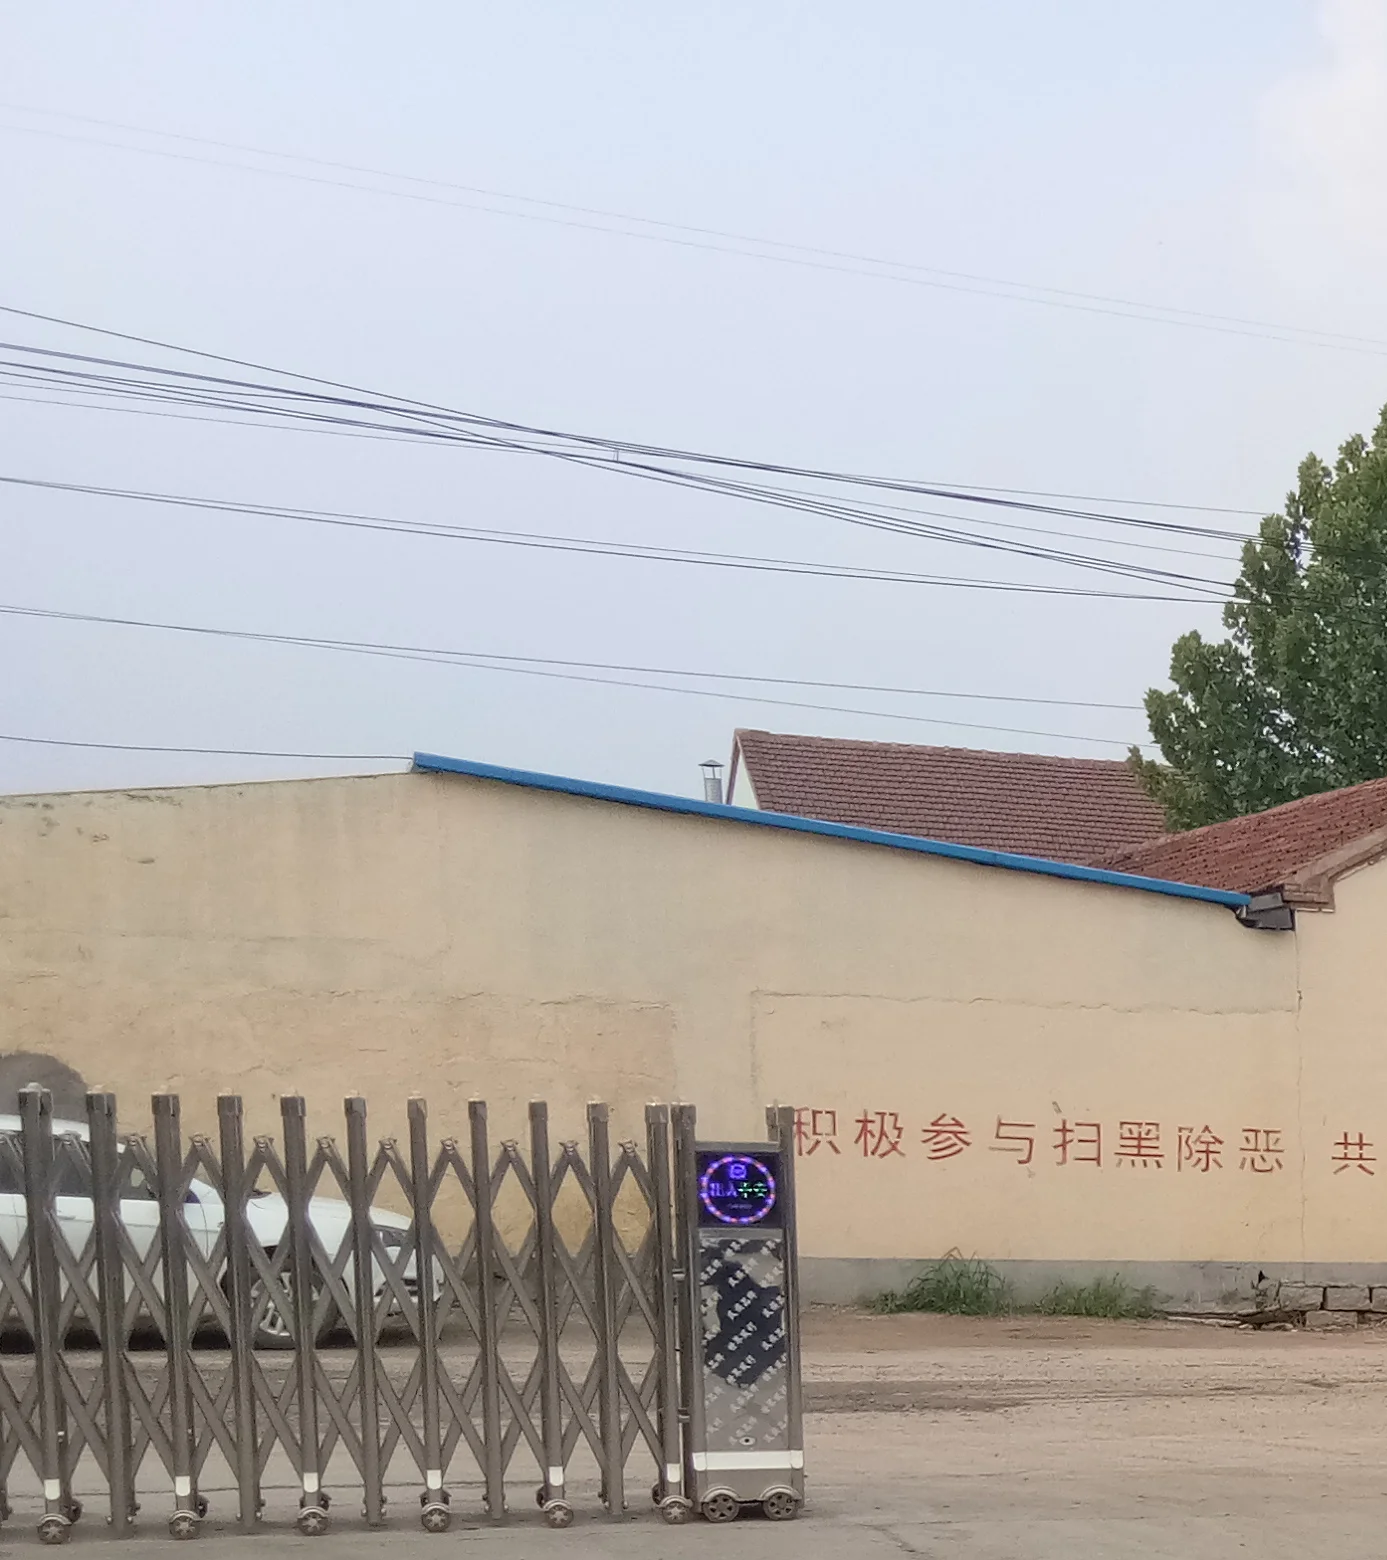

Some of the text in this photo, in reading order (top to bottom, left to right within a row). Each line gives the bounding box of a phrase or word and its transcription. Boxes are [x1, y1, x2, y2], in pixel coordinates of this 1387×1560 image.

[794, 1105, 1285, 1173] 积极参与扫黑除恶
